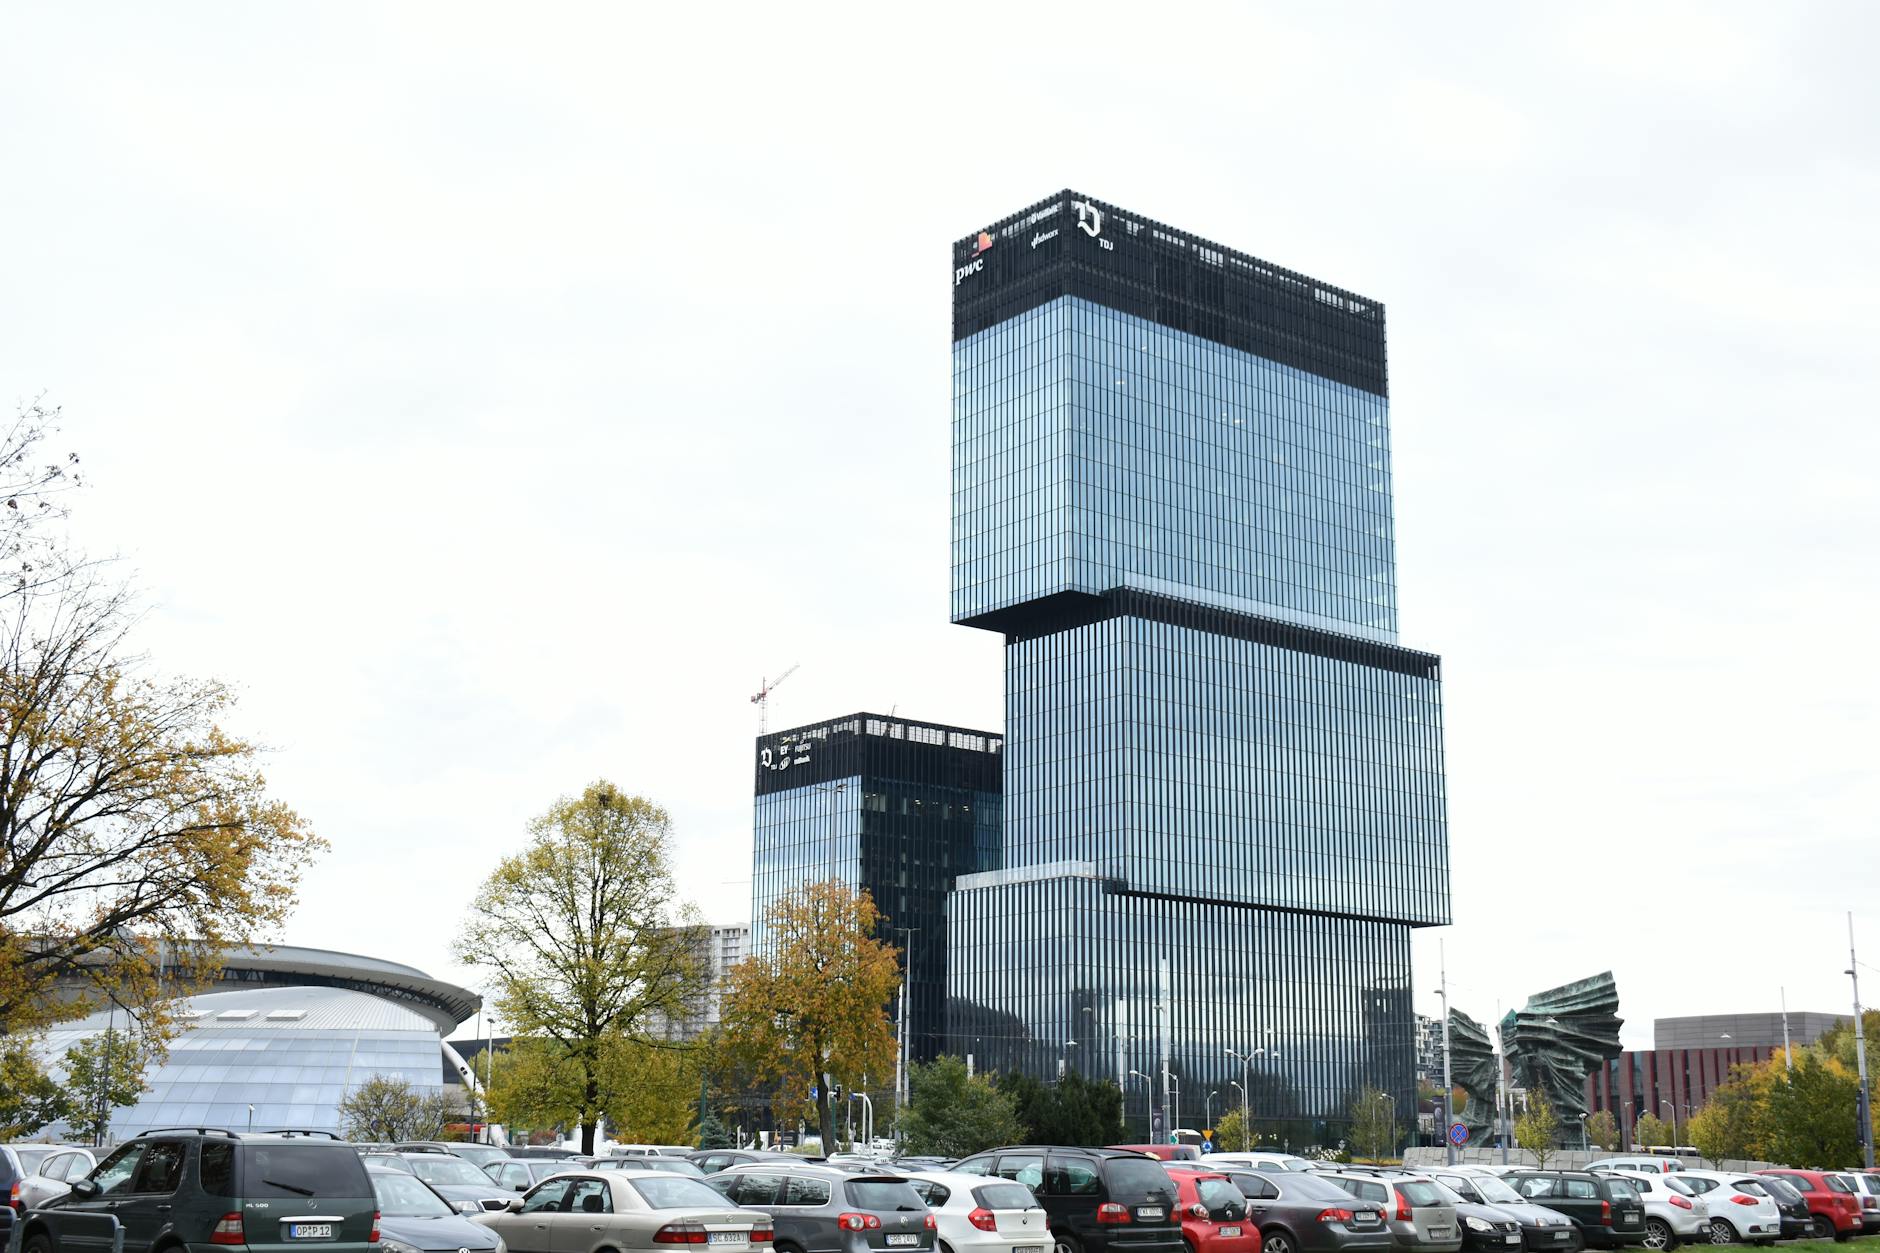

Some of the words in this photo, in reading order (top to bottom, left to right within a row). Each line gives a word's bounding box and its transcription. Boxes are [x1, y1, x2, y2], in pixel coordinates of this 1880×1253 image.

[1098, 238, 1114, 250] TDJ
[956, 258, 983, 286] pwc
[780, 745, 788, 755] EY
[296, 1226, 308, 1236] OP
[319, 1226, 331, 1236] 12
